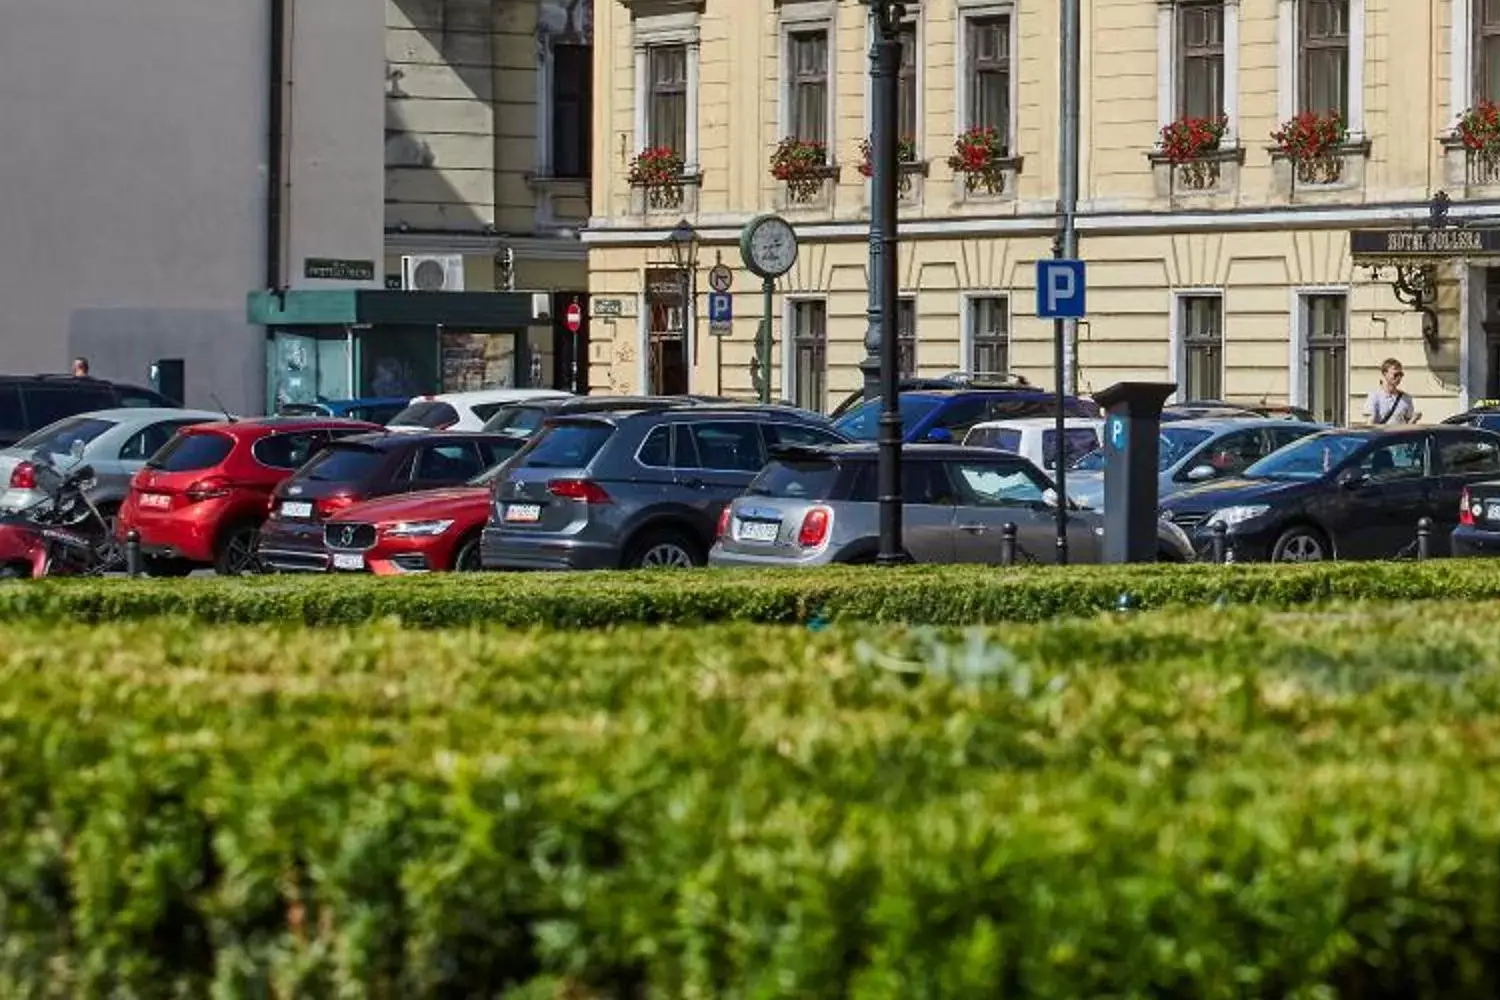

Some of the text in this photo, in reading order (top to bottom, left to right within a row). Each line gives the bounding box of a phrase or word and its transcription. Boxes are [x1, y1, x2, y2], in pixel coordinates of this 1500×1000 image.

[1047, 266, 1075, 311] P
[715, 296, 728, 317] P
[1113, 421, 1123, 443] P
